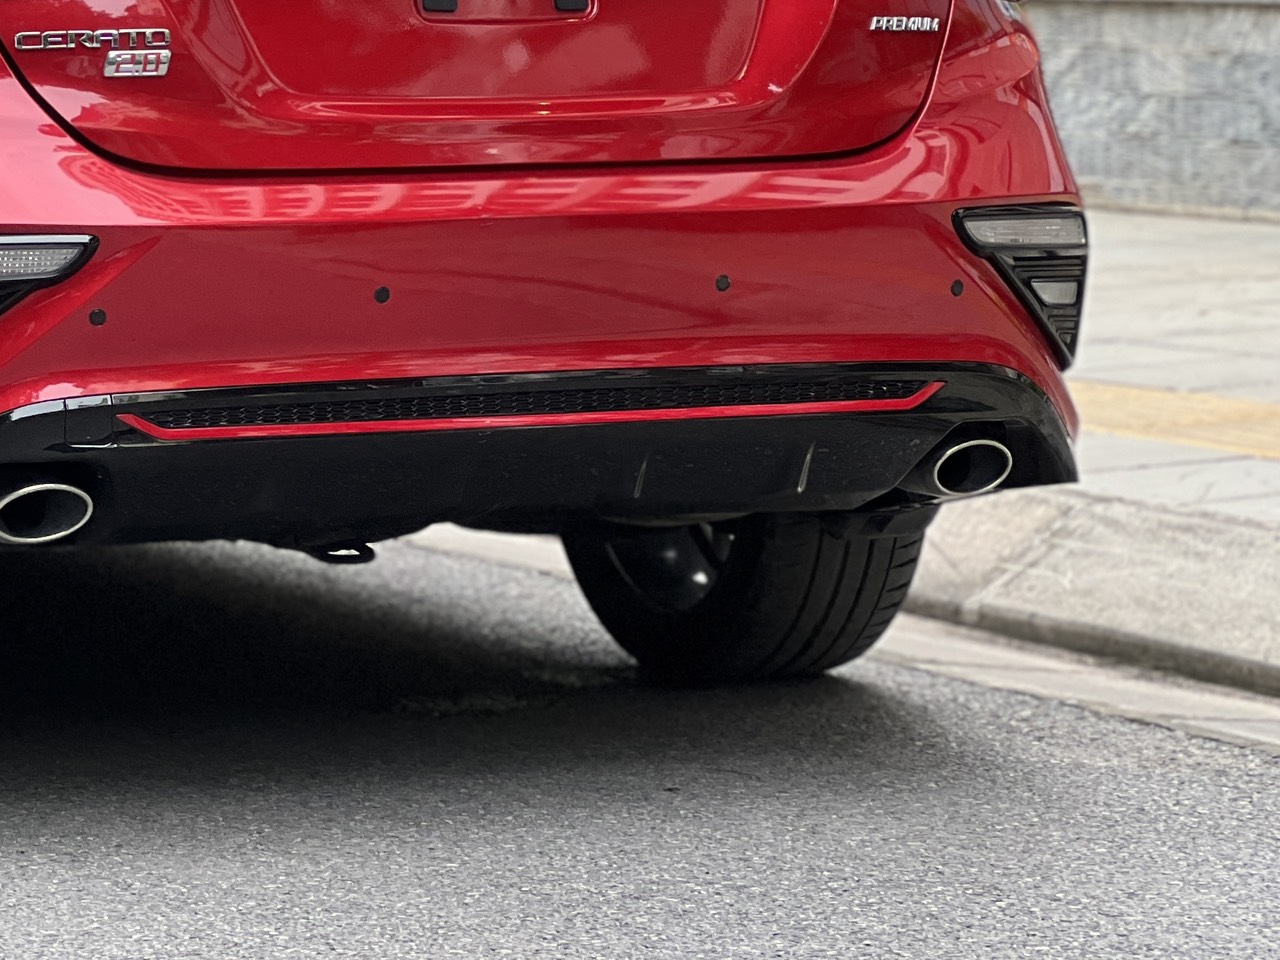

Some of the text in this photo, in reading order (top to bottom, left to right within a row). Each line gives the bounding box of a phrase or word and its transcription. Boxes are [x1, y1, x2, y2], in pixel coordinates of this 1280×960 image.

[869, 16, 940, 32] PREMIUM
[14, 28, 172, 50] CERATO
[111, 52, 165, 77] 2.0
